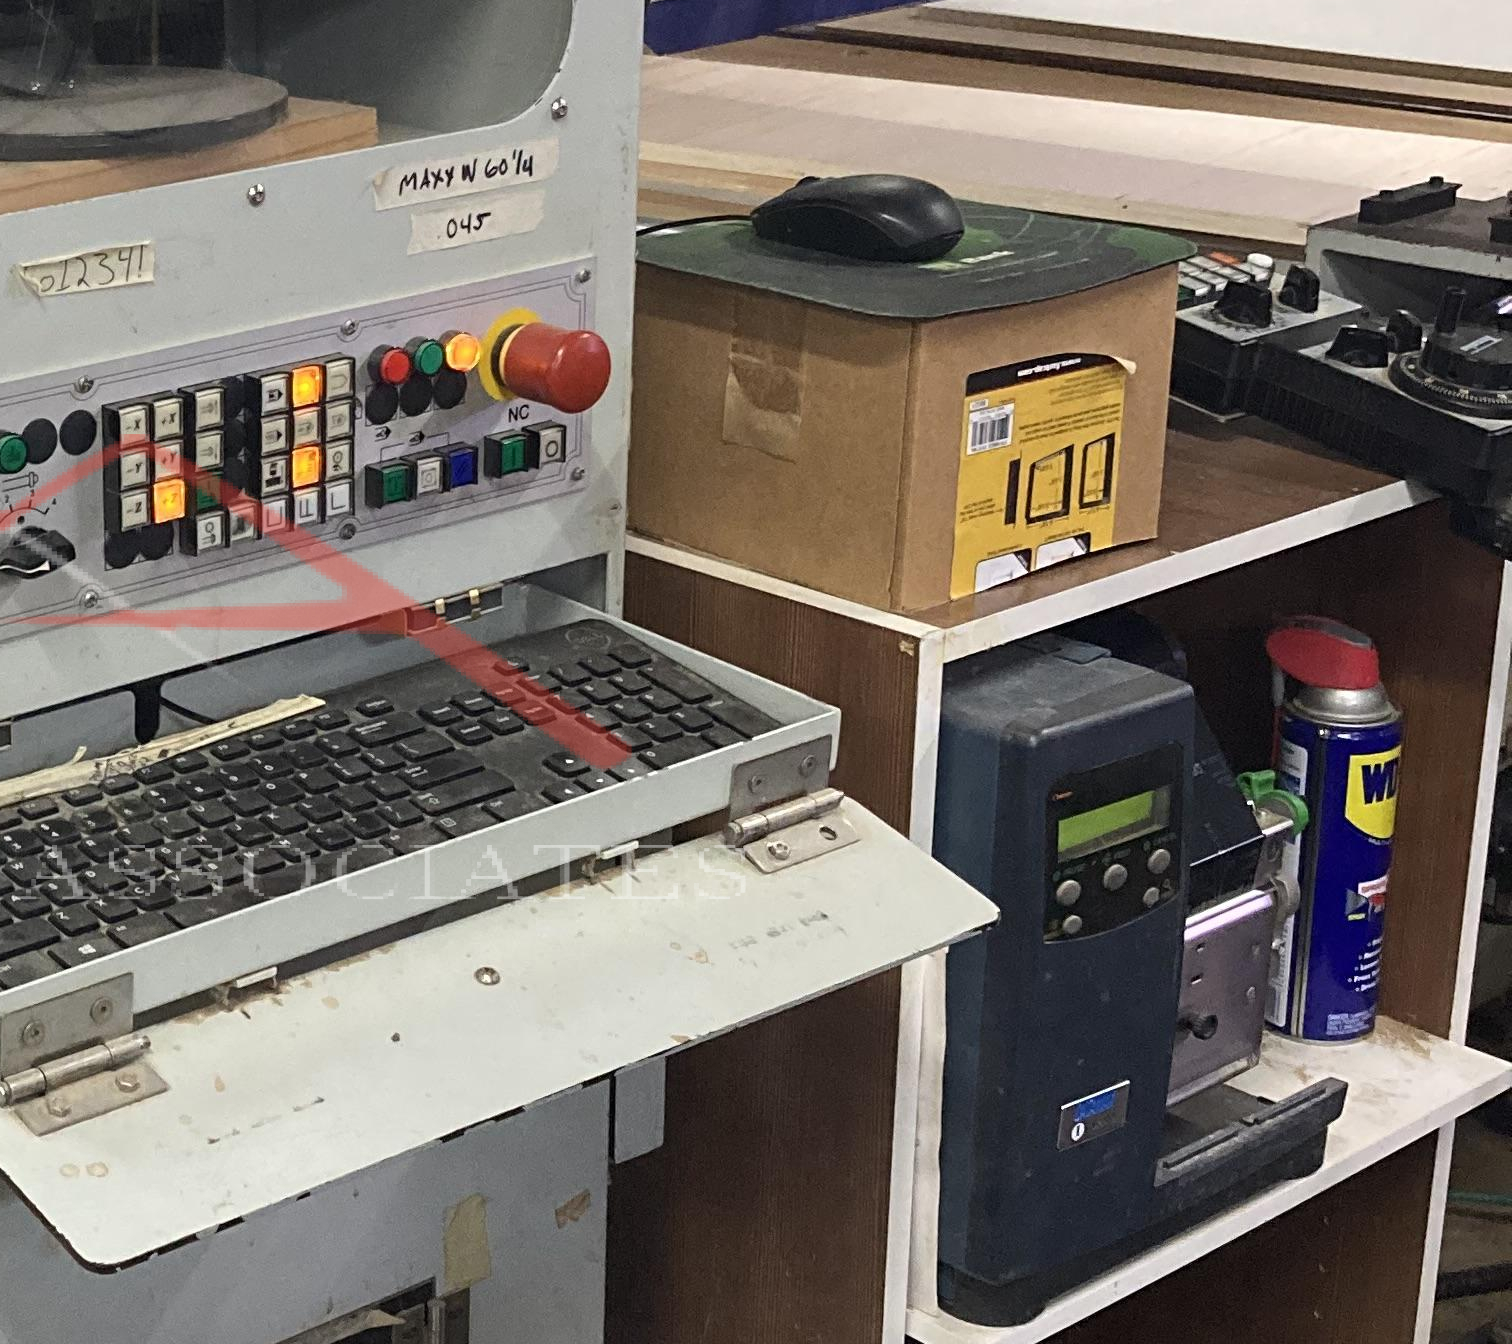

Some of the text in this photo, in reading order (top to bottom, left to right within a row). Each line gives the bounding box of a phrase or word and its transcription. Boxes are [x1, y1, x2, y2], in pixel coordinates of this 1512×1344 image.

[484, 158, 508, 179] 60
[161, 411, 177, 426] +X
[508, 405, 530, 422] NC
